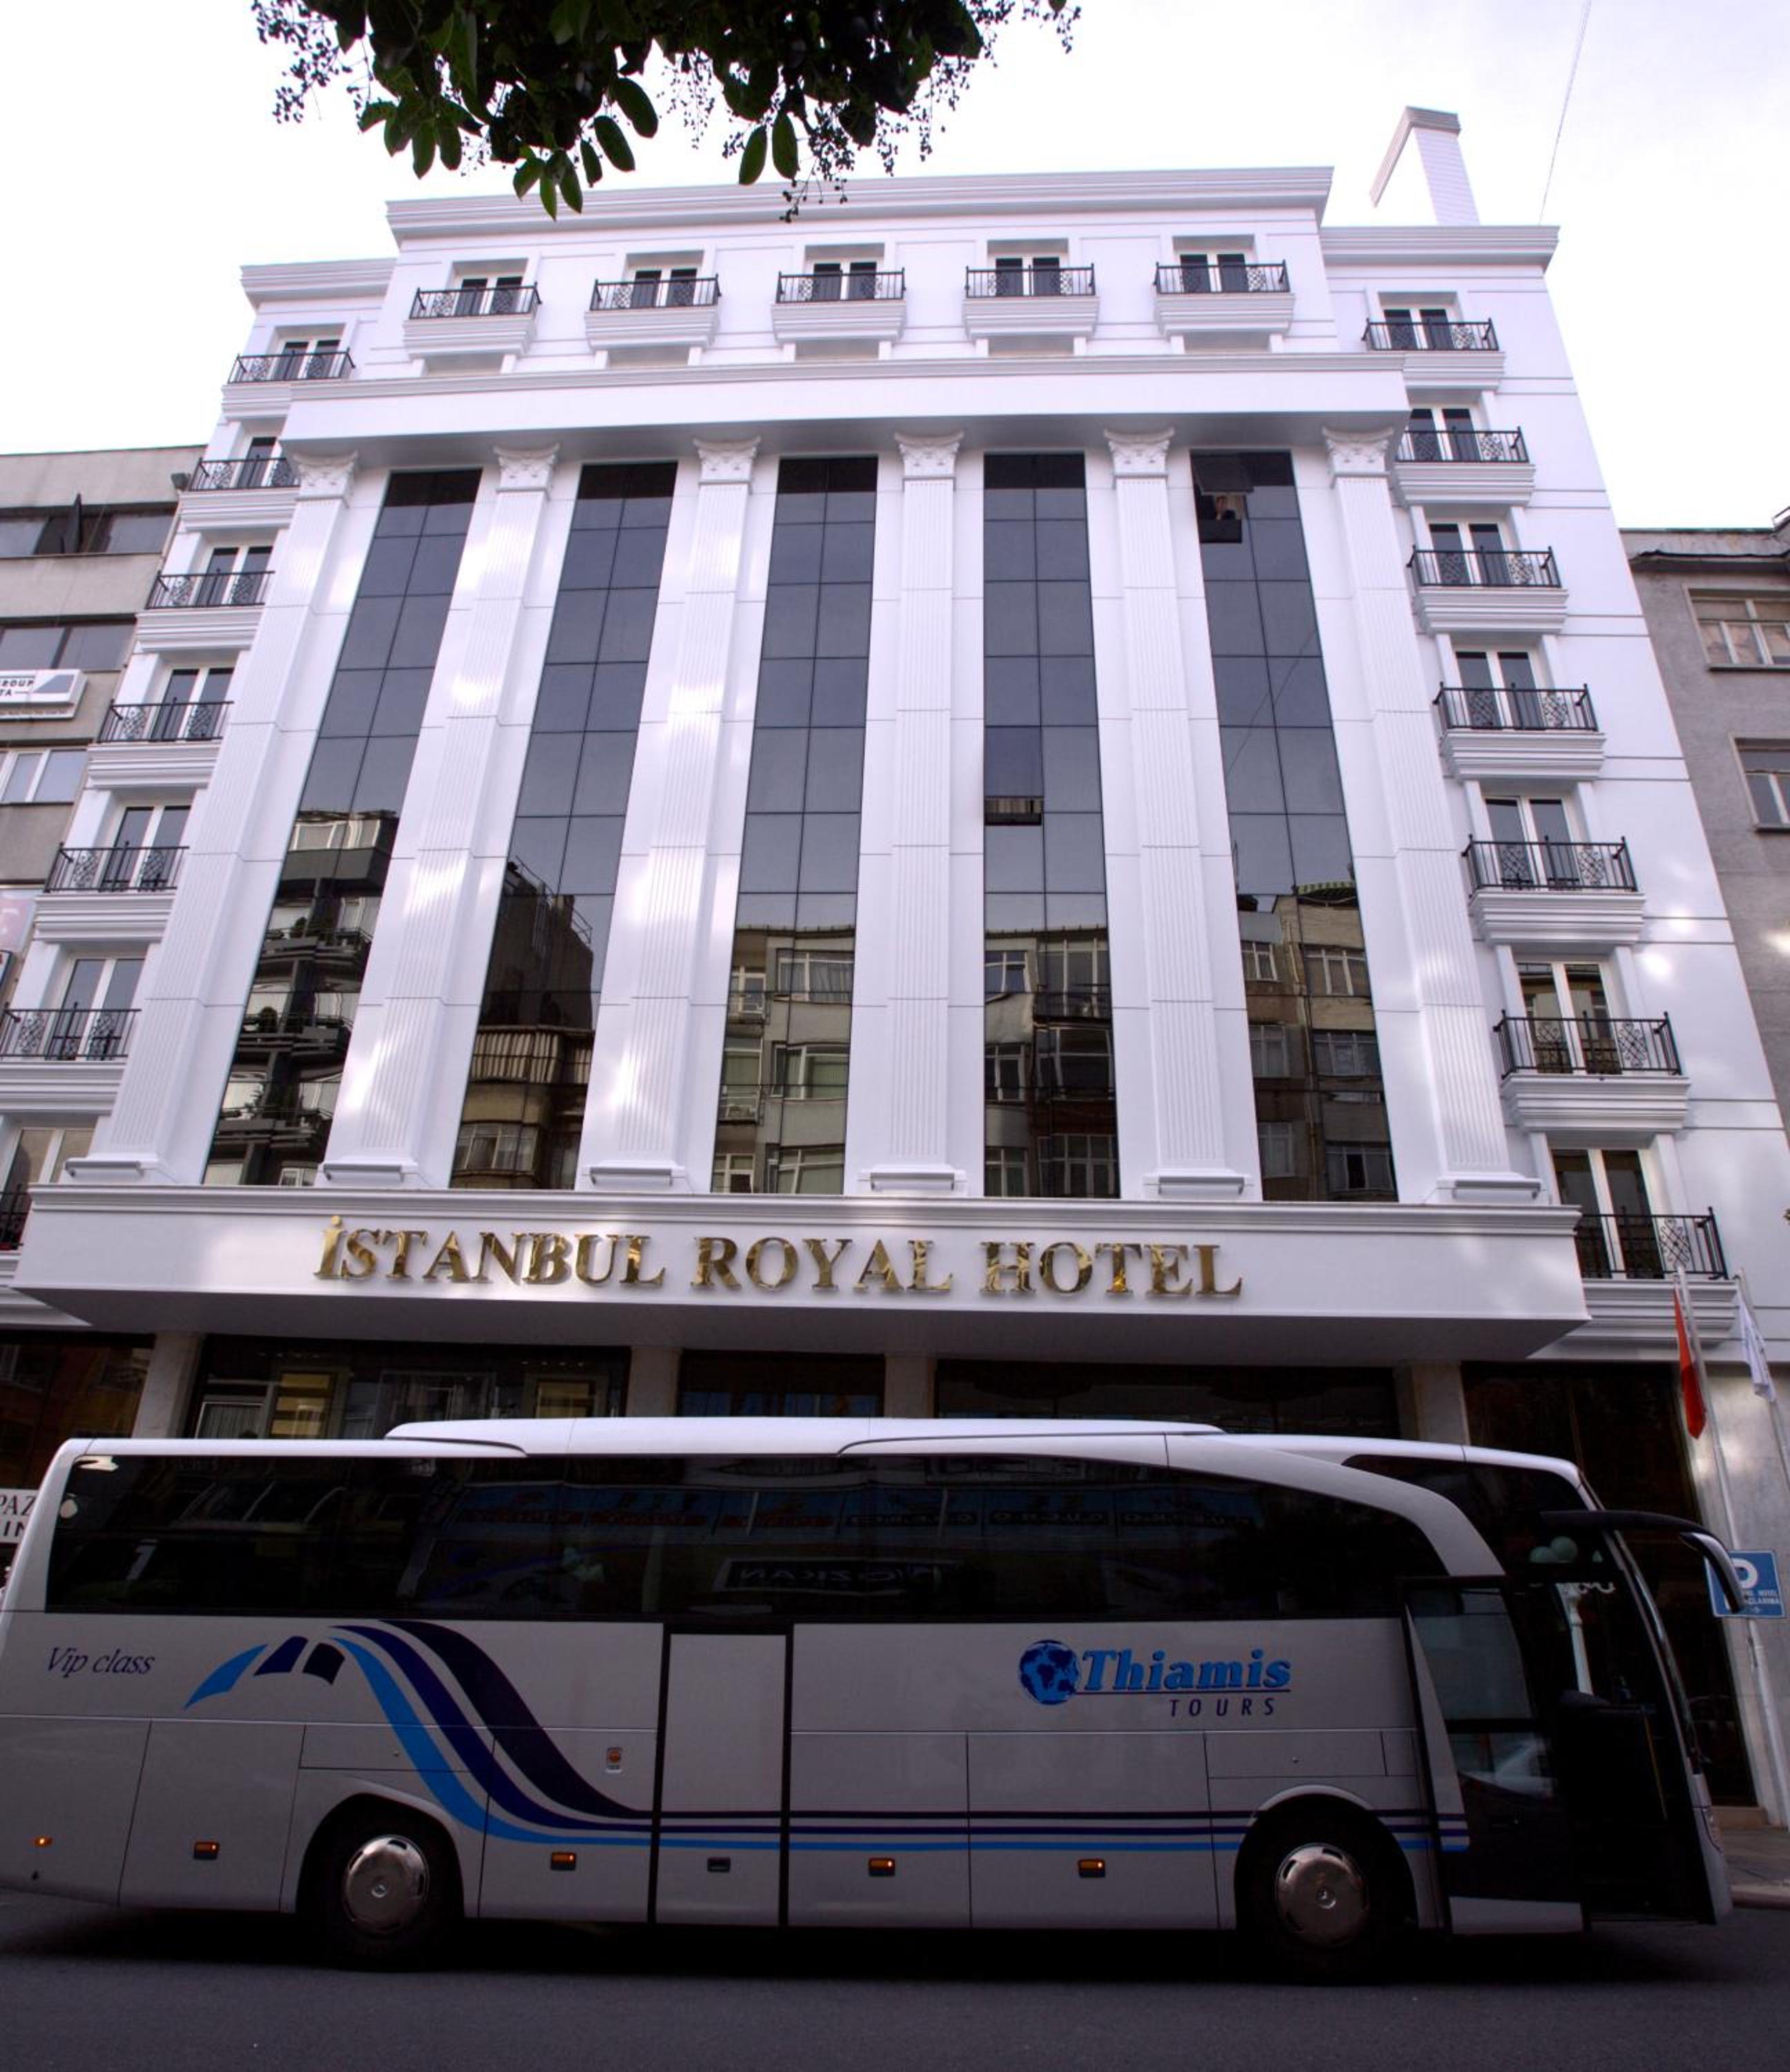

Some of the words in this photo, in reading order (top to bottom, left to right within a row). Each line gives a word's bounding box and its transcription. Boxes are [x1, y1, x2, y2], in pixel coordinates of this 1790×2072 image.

[690, 1236, 954, 1292] ROYAL
[979, 1240, 1243, 1298] HOTEL
[46, 1647, 88, 1678] Vip
[93, 1649, 156, 1674] class
[1082, 1649, 1291, 1691] Thiamis
[1169, 1697, 1276, 1717] TOURS
